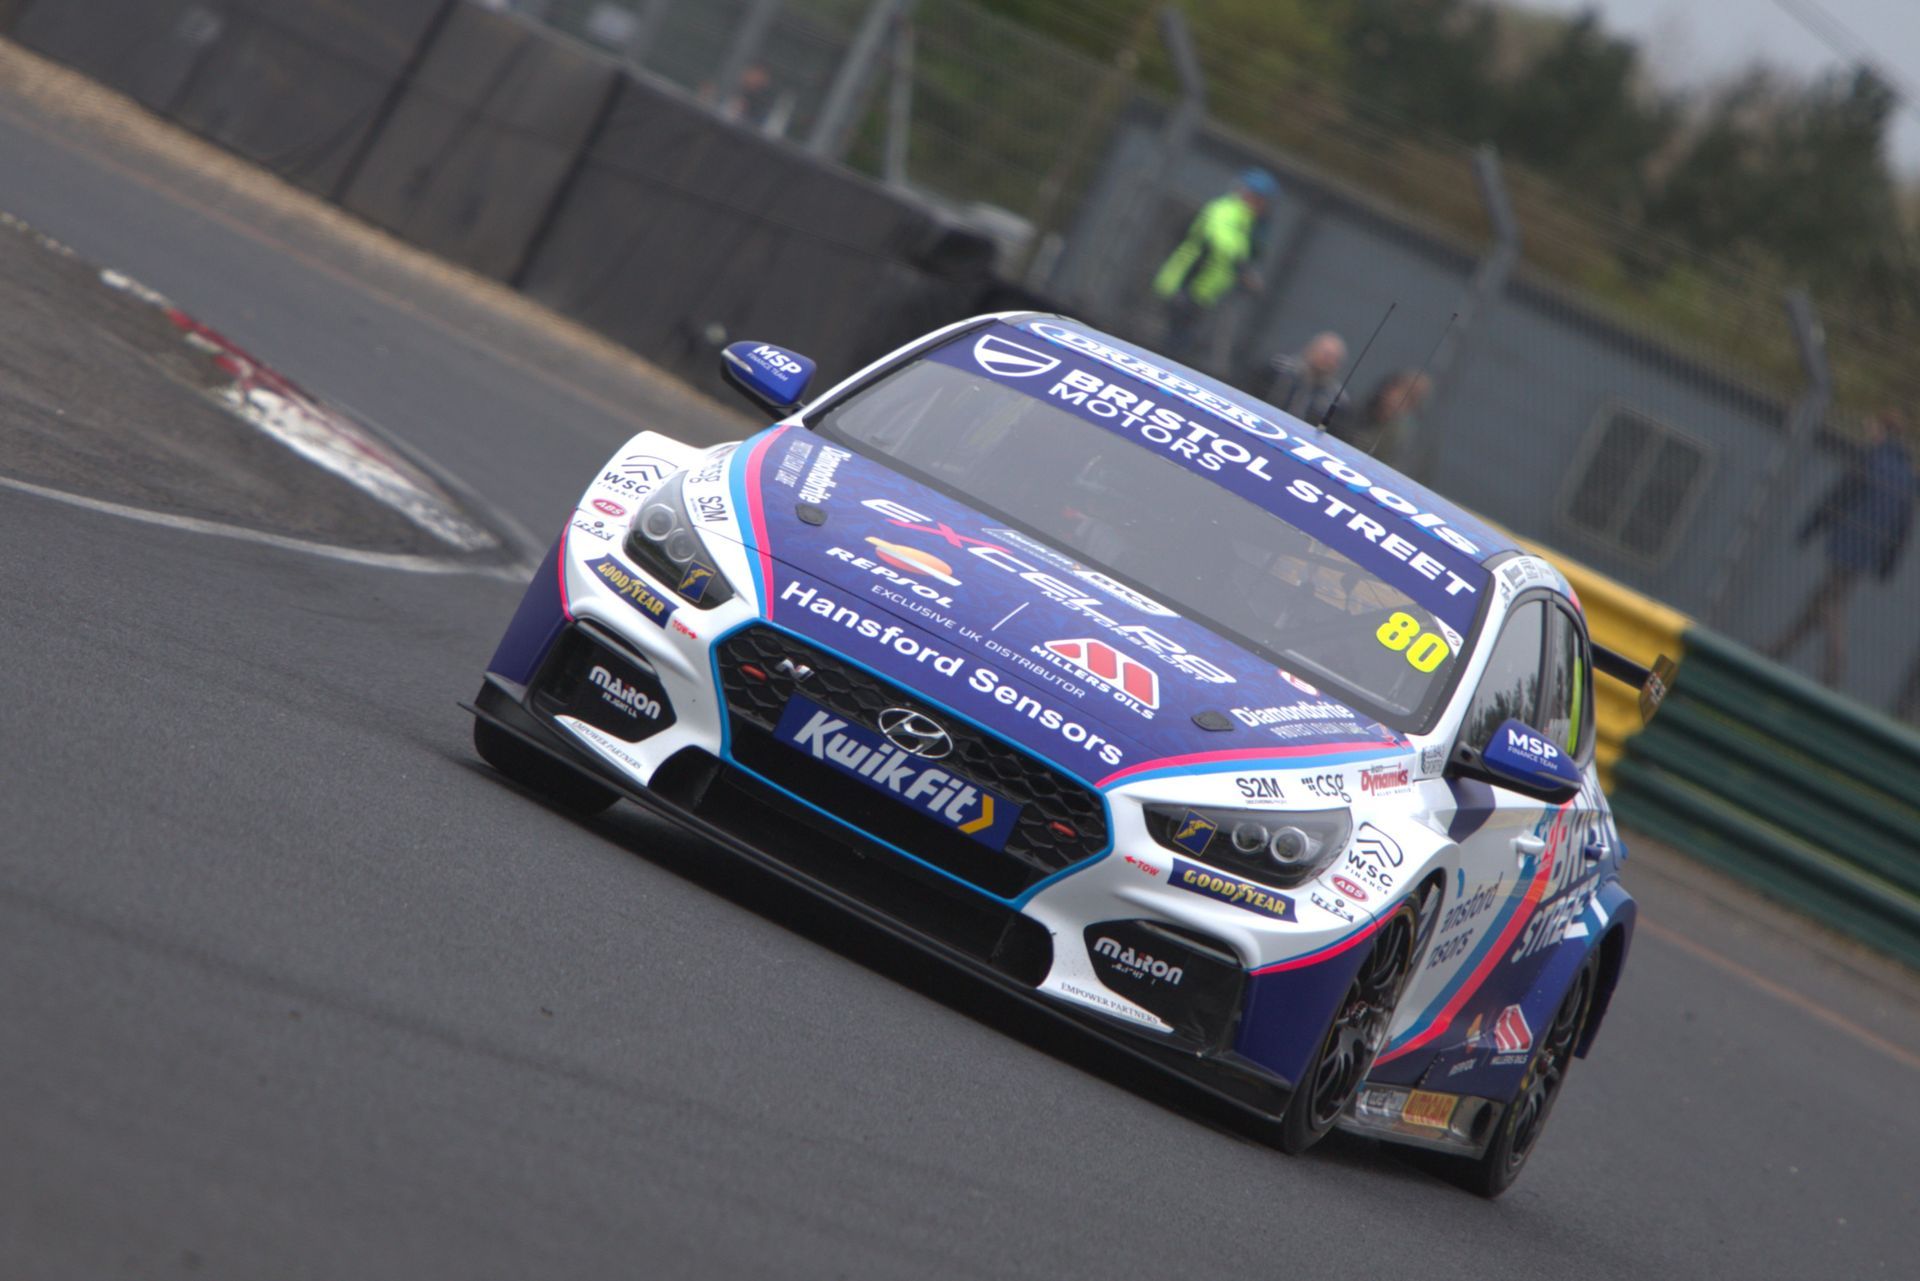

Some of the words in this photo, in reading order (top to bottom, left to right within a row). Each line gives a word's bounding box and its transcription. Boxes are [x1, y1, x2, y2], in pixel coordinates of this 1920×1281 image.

[752, 345, 802, 374] MSP
[1053, 330, 1268, 430] DRAPER
[1048, 382, 1225, 472] MOTORS
[597, 481, 640, 501] FINANCE
[603, 471, 652, 495] WSC
[1061, 368, 1273, 482] BRISTOL
[1285, 479, 1476, 597] STREET
[596, 500, 624, 516] ABS
[698, 495, 729, 522] S2M
[826, 546, 955, 609] REPSOL
[672, 619, 689, 635] TOW
[871, 584, 957, 630] EXCLUSIVE
[959, 626, 984, 643] UK
[984, 640, 1086, 699] DISTRIBUTOR
[1376, 611, 1450, 673] 80
[781, 580, 965, 678] Hansford
[968, 667, 1124, 767] Sensors
[1030, 644, 1111, 694] MILLERS
[1113, 690, 1155, 720] OILS
[1231, 700, 1355, 728] Diamondbrite
[1507, 729, 1559, 760] MSP
[1507, 745, 1539, 763] FINANCE
[1538, 755, 1559, 770] TEAM
[1235, 777, 1285, 799] S2M
[1135, 859, 1160, 877] TOW
[1344, 864, 1389, 896] FINANCE
[1348, 849, 1394, 888] WSC
[1183, 868, 1287, 916] GOODYEAR
[1335, 879, 1365, 900] ABS
[1060, 981, 1111, 1007] EMPOWER
[1110, 999, 1159, 1025] PARTNERS
